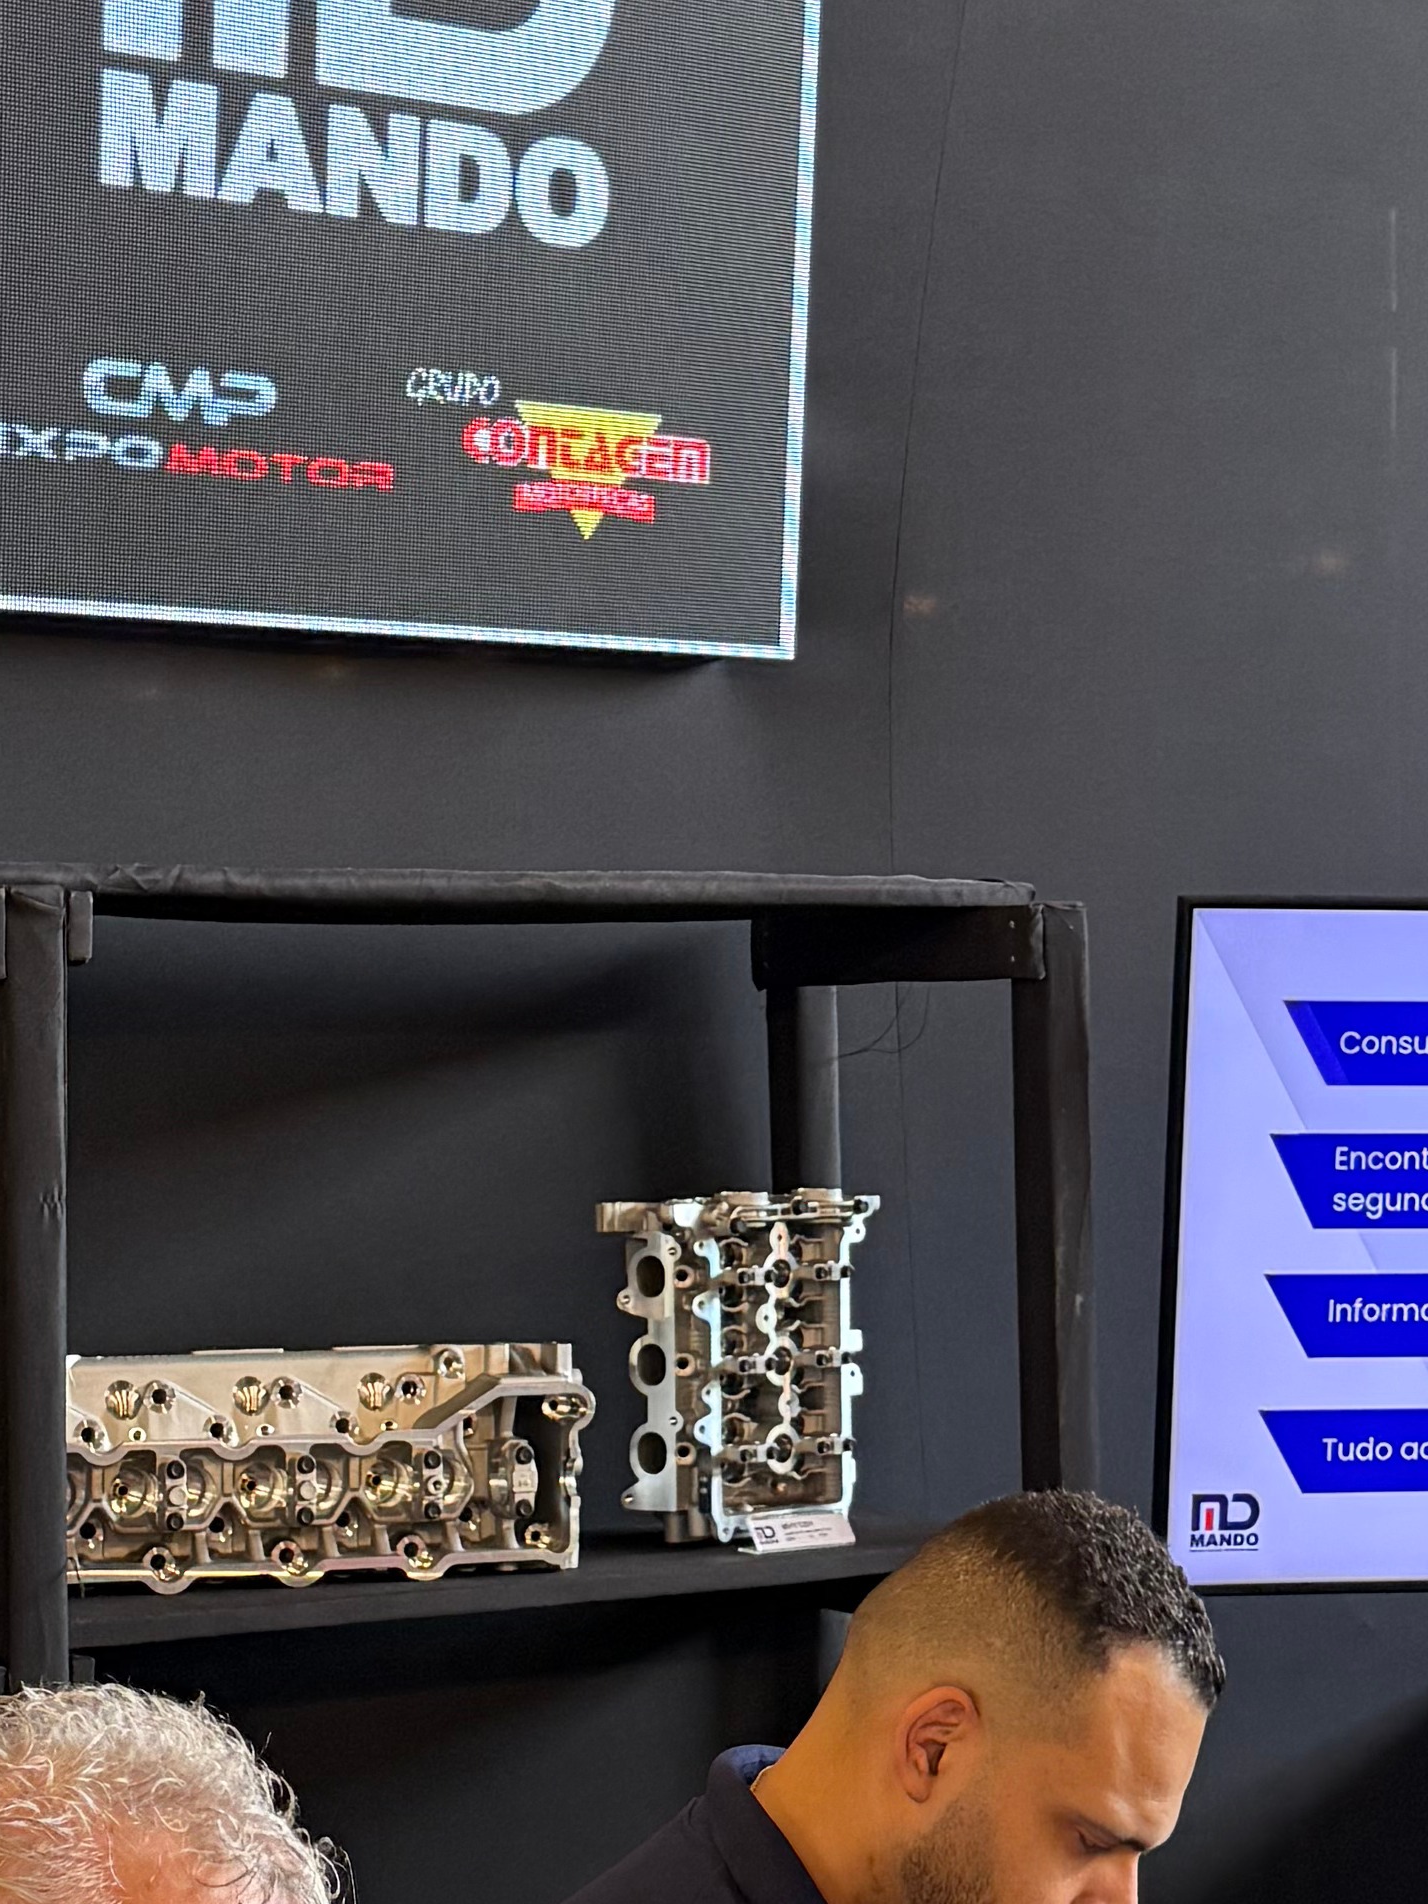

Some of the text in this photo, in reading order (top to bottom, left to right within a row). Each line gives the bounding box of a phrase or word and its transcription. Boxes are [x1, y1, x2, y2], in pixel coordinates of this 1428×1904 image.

[98, 69, 610, 248] MANDO
[83, 357, 278, 426] CMP
[406, 367, 501, 407] GRUPO
[461, 416, 711, 484] CONTAGEM
[1322, 1437, 1393, 1462] Tudo
[1190, 1532, 1259, 1547] MANDO
